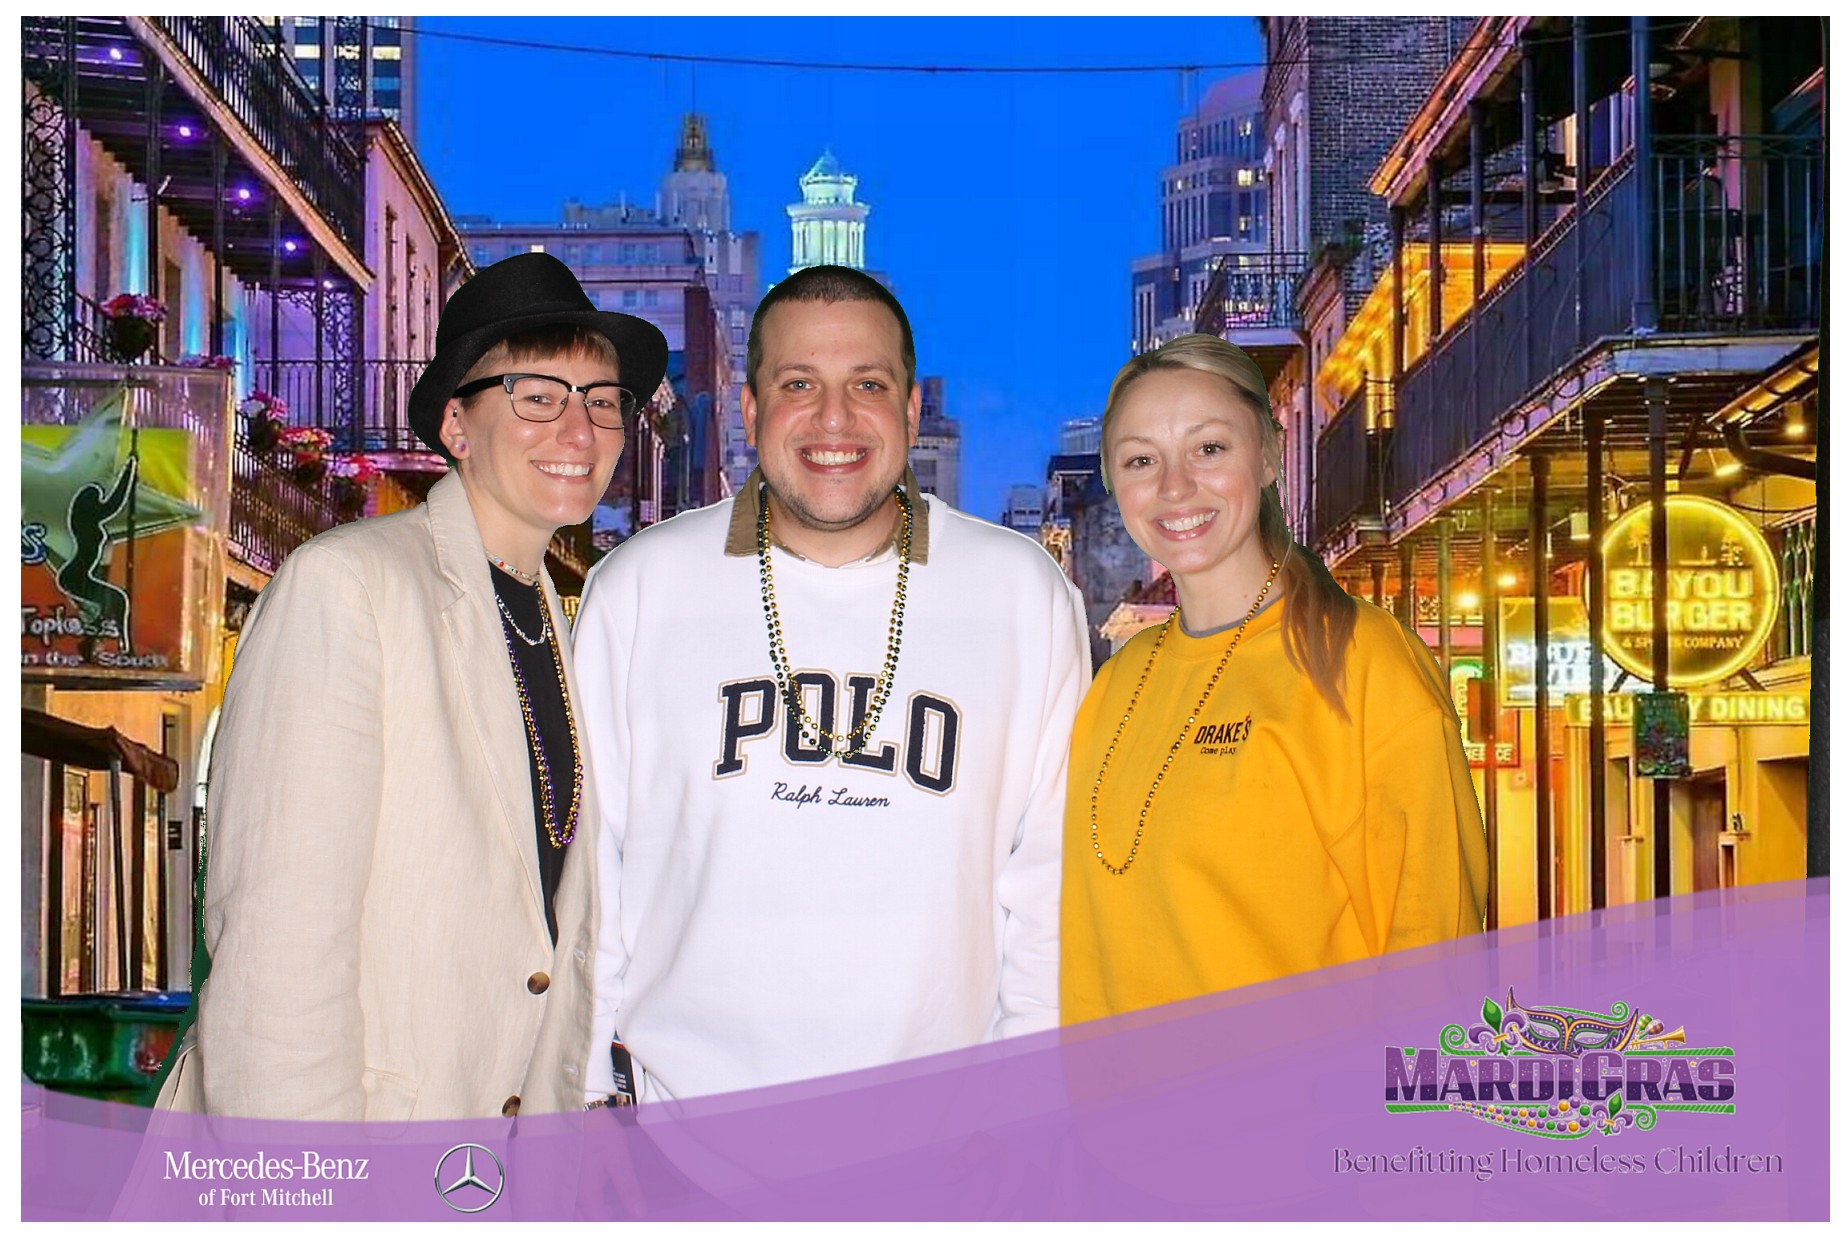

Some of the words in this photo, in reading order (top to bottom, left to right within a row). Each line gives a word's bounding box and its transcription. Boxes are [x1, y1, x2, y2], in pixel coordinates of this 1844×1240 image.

[1610, 601, 1753, 630] BURGER
[1684, 635, 1744, 649] COMPANY
[1709, 696, 1806, 721] DINING
[712, 667, 963, 797] POLO
[1193, 711, 1252, 744] DRAKE'S
[1200, 746, 1218, 754] Come
[1219, 746, 1238, 757] play
[770, 781, 822, 809] Ralph
[827, 787, 891, 808] Lauren
